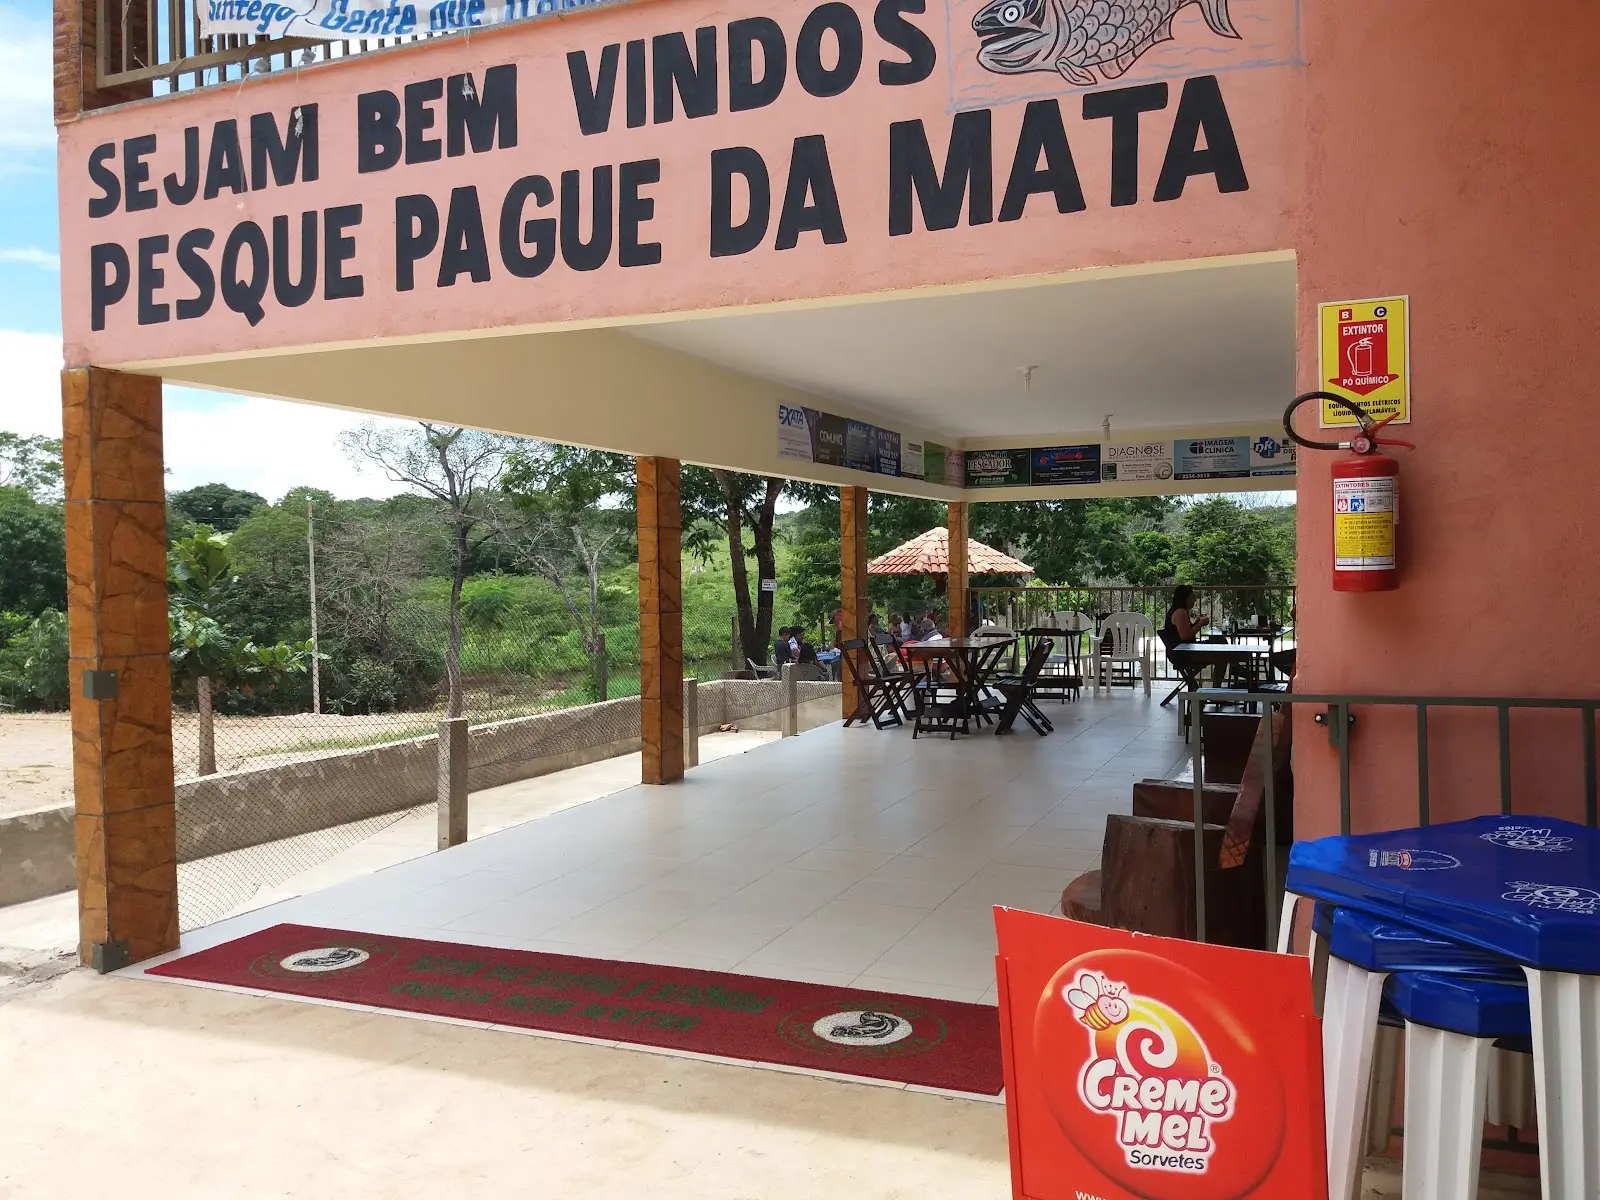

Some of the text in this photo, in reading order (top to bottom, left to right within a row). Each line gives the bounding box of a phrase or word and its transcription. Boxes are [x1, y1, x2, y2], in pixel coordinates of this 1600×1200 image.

[319, 0, 417, 36] Gente
[88, 0, 937, 219] SEJAM BEM VINDOS
[90, 75, 1250, 332] PESQUE PAGUE DA MATA
[1341, 311, 1350, 319] B
[1376, 307, 1385, 317] C
[1342, 323, 1384, 336] EXTINTOR
[1342, 375, 1389, 387] PÓ QUÍMICO
[1372, 399, 1401, 407] ELÉTRICOS
[778, 404, 804, 427] EXATA
[1204, 439, 1235, 447] IMAGEM
[1335, 481, 1370, 489] EXTINTORES
[1129, 1149, 1205, 1171] Sorvetes
